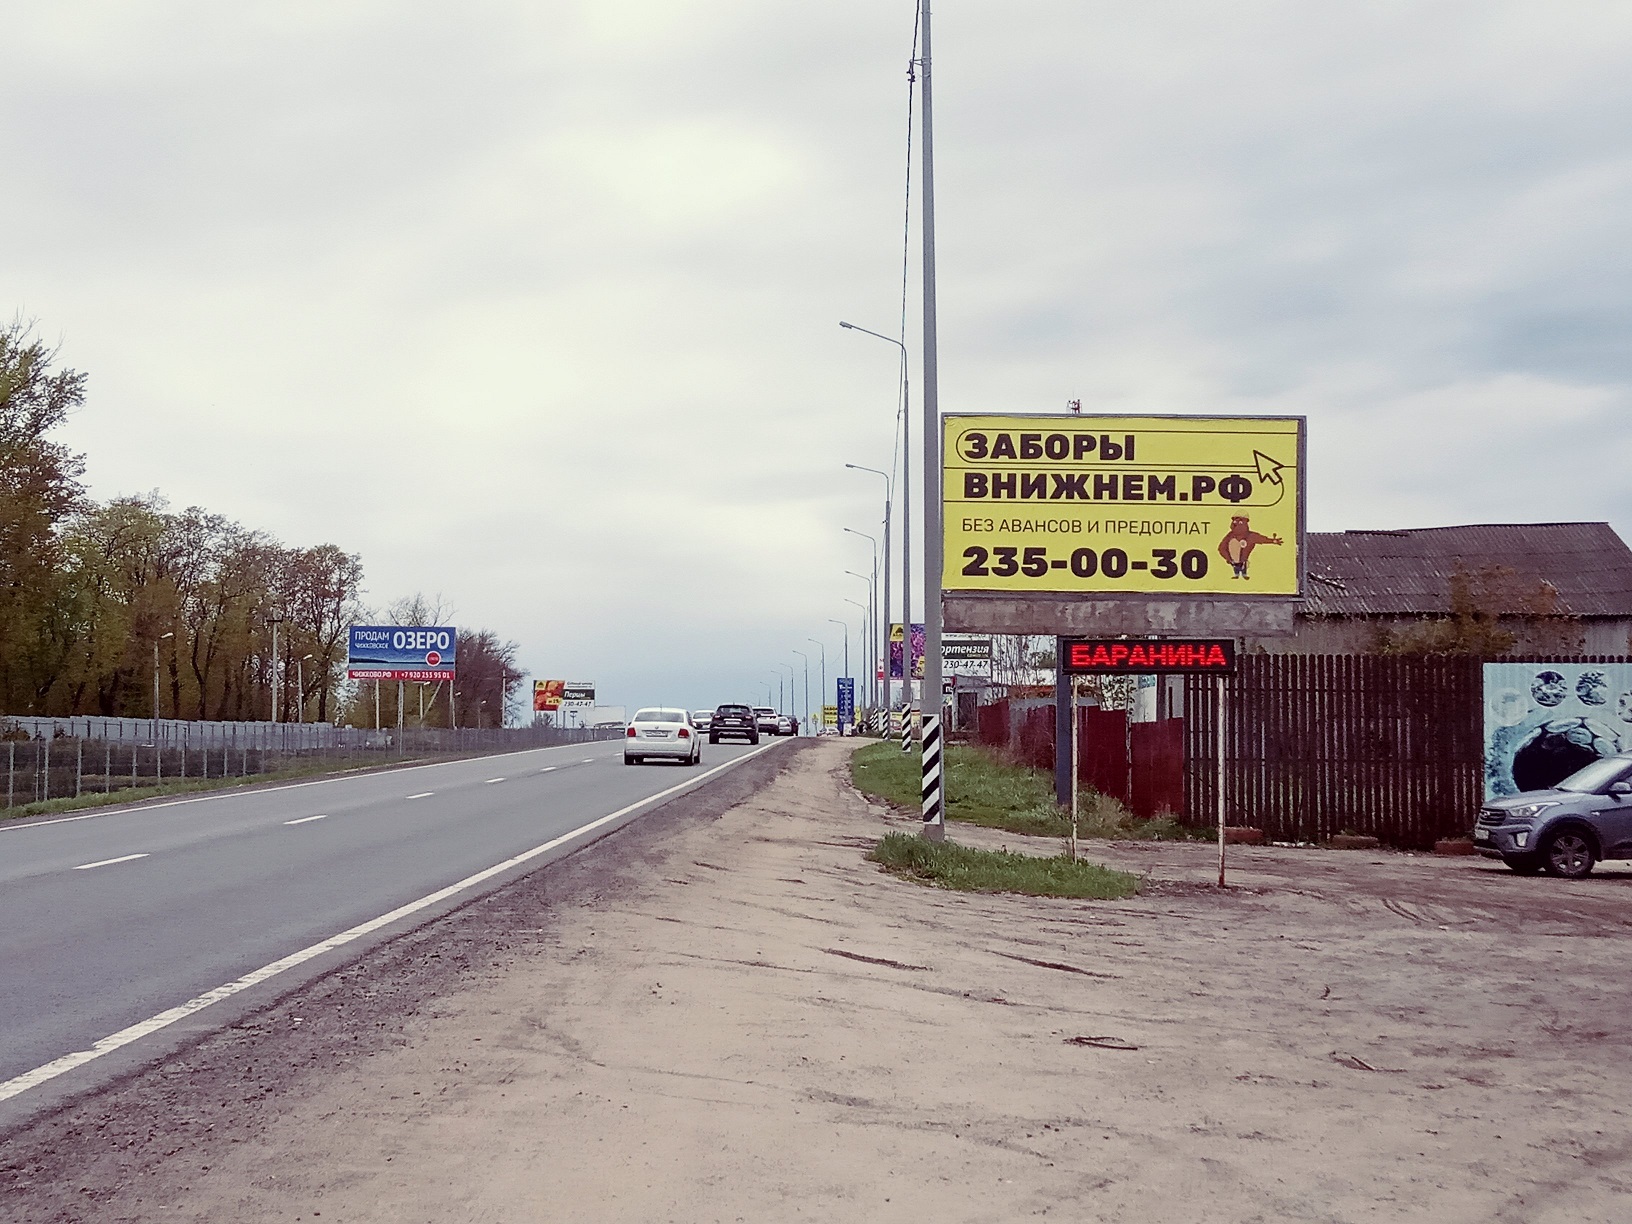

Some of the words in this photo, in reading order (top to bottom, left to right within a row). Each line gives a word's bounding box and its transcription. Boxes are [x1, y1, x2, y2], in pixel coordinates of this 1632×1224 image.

[964, 432, 1135, 461] ЗАБОРЫ
[963, 472, 1253, 503] ВНИЖНЕМ.РФ
[962, 518, 994, 533] БЕЗ
[999, 519, 1082, 534] АВАНСОВ
[1087, 520, 1099, 534] И
[1104, 520, 1211, 537] ПРЕДОПЛАТ
[961, 546, 1209, 579] 235-00-30
[355, 631, 389, 641] ПРОДАМ
[393, 631, 450, 650] ОЗЕРО
[941, 645, 989, 655] ортензия
[1071, 644, 1226, 666] БАРАНИНА
[943, 660, 988, 668] 230-47-47
